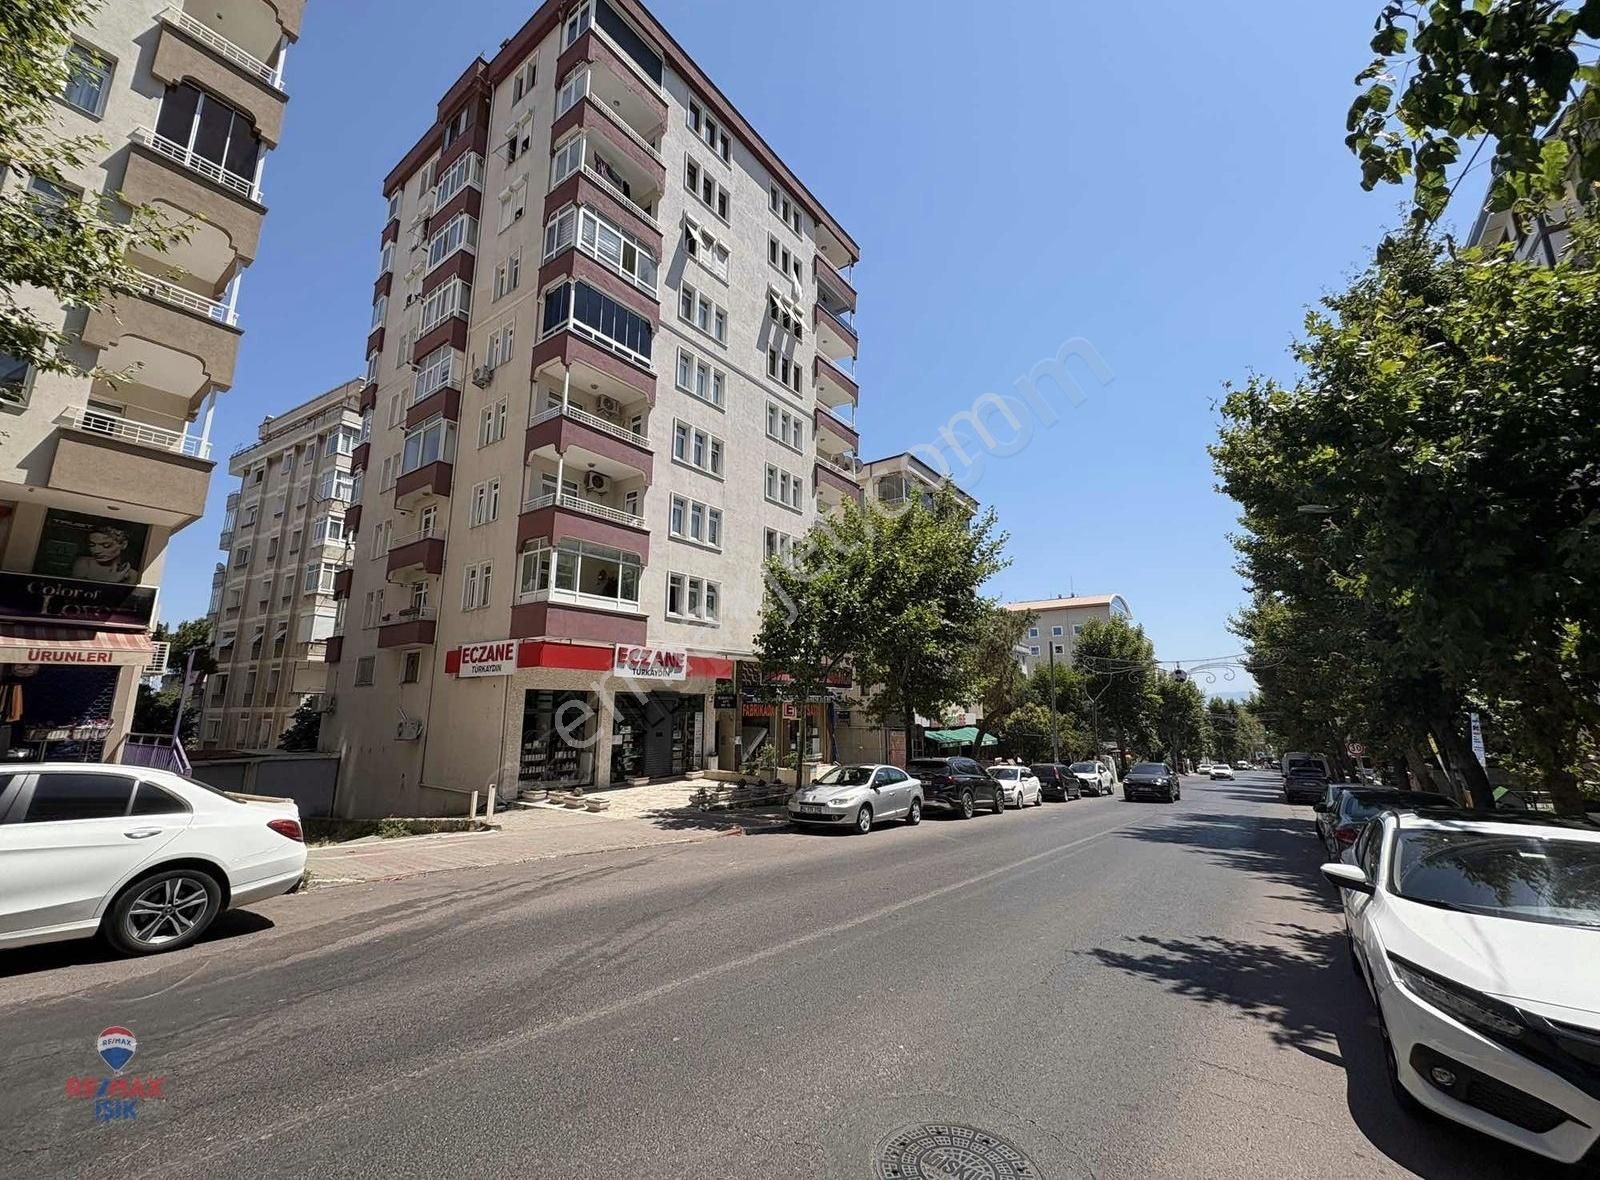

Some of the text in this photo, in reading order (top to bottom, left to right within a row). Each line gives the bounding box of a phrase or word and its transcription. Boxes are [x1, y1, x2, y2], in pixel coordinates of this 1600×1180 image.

[27, 581, 101, 600] Color of
[462, 643, 514, 664] ECZANE
[618, 647, 685, 670] ECZANE
